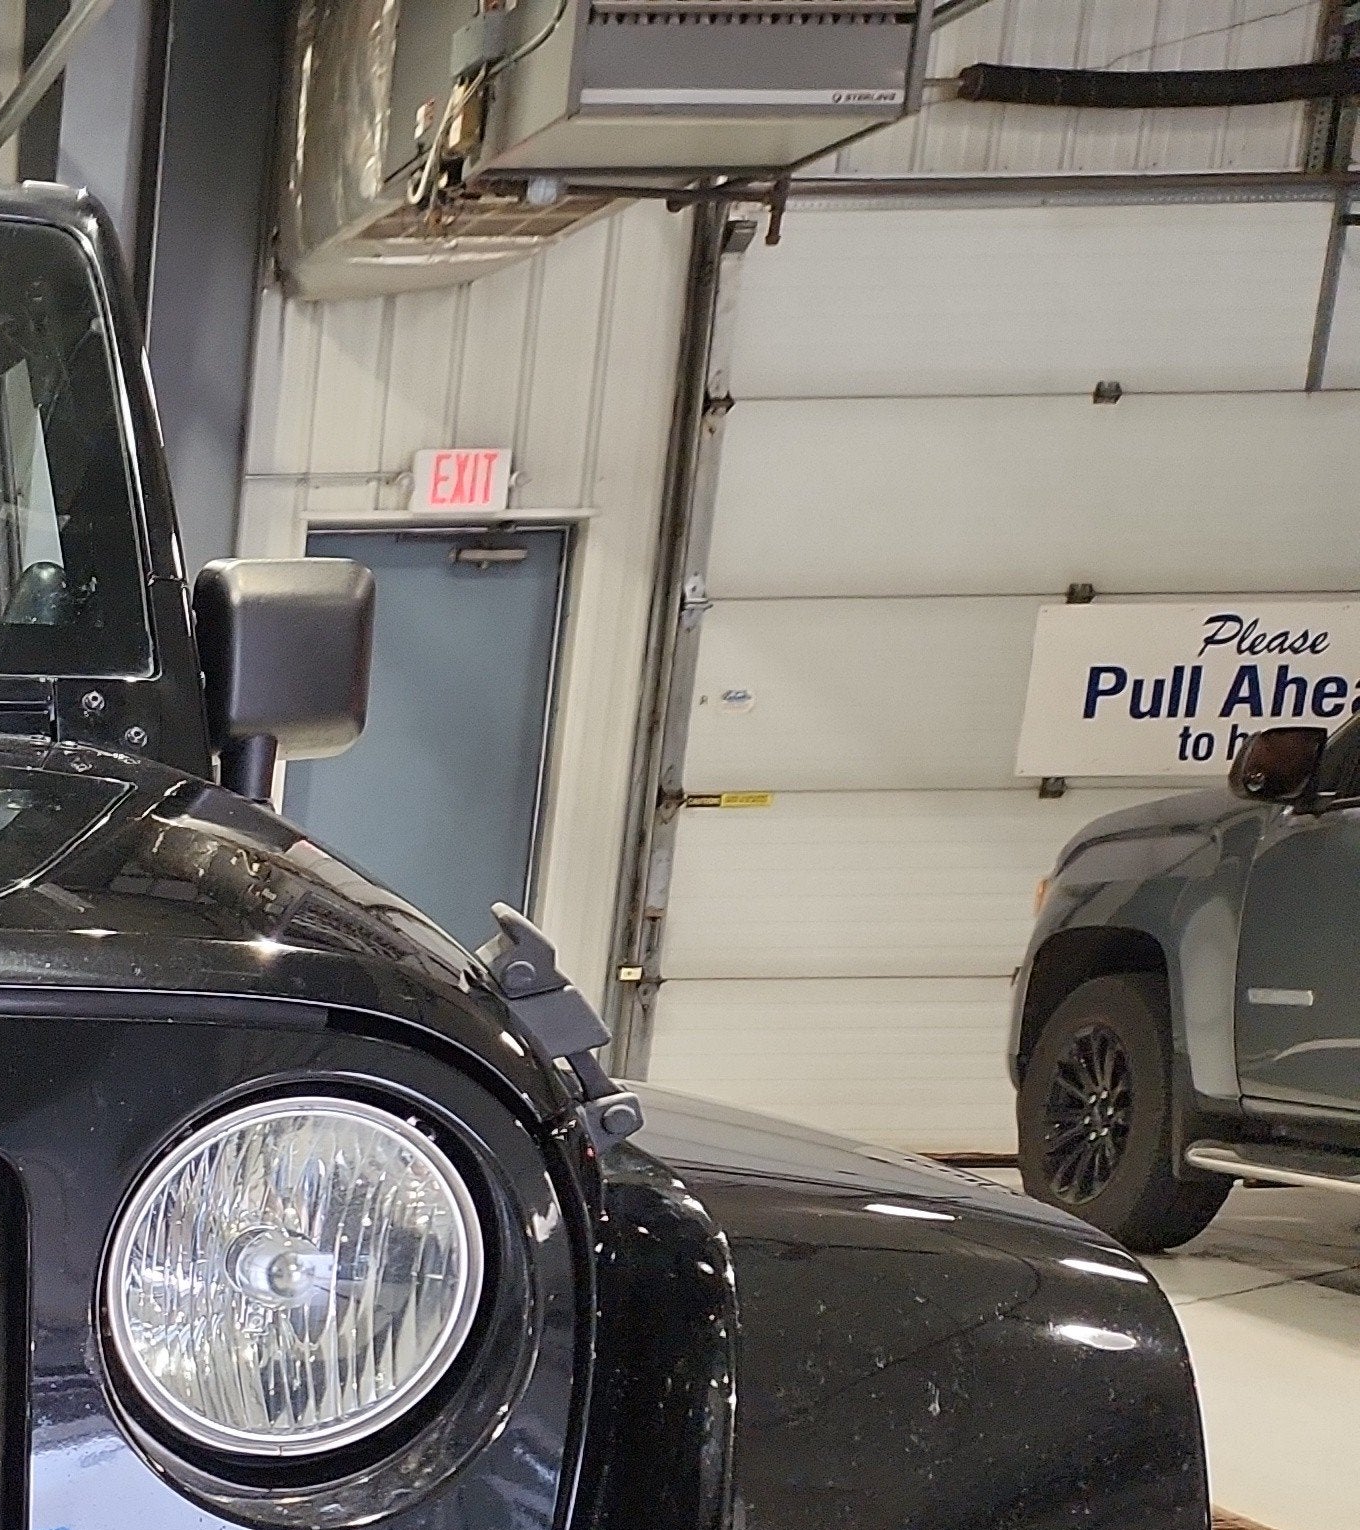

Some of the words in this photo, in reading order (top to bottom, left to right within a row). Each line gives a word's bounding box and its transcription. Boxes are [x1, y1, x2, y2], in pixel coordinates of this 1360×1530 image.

[428, 452, 499, 504] EXIT
[1197, 613, 1330, 658] Please
[1082, 664, 1203, 719] Pull
[1218, 664, 1360, 718] Ahe
[1178, 725, 1215, 761] to
